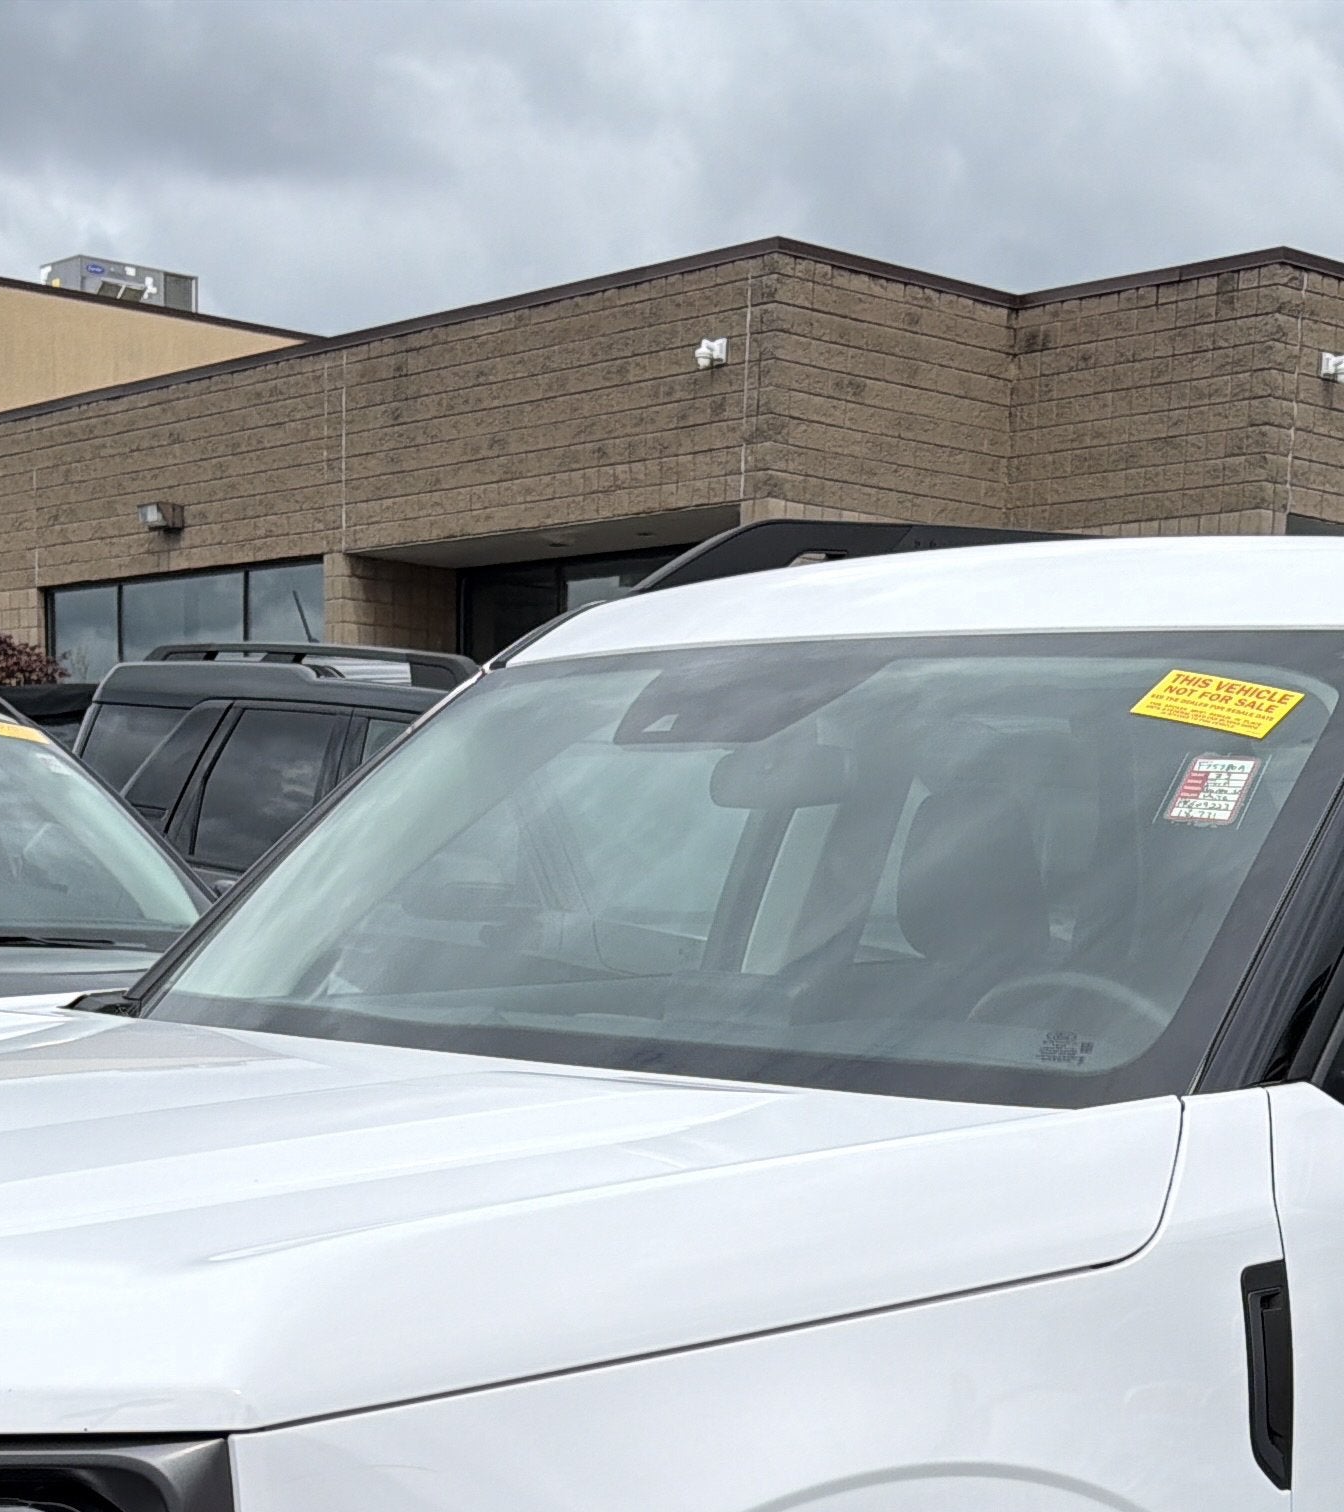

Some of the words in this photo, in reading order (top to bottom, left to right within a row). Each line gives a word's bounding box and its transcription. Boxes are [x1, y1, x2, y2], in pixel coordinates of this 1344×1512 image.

[1164, 684, 1199, 699] NOT
[1198, 691, 1233, 705] FOR
[1234, 698, 1280, 714] SALE
[1171, 672, 1214, 689] THIS
[1214, 680, 1295, 706] VEHICLE
